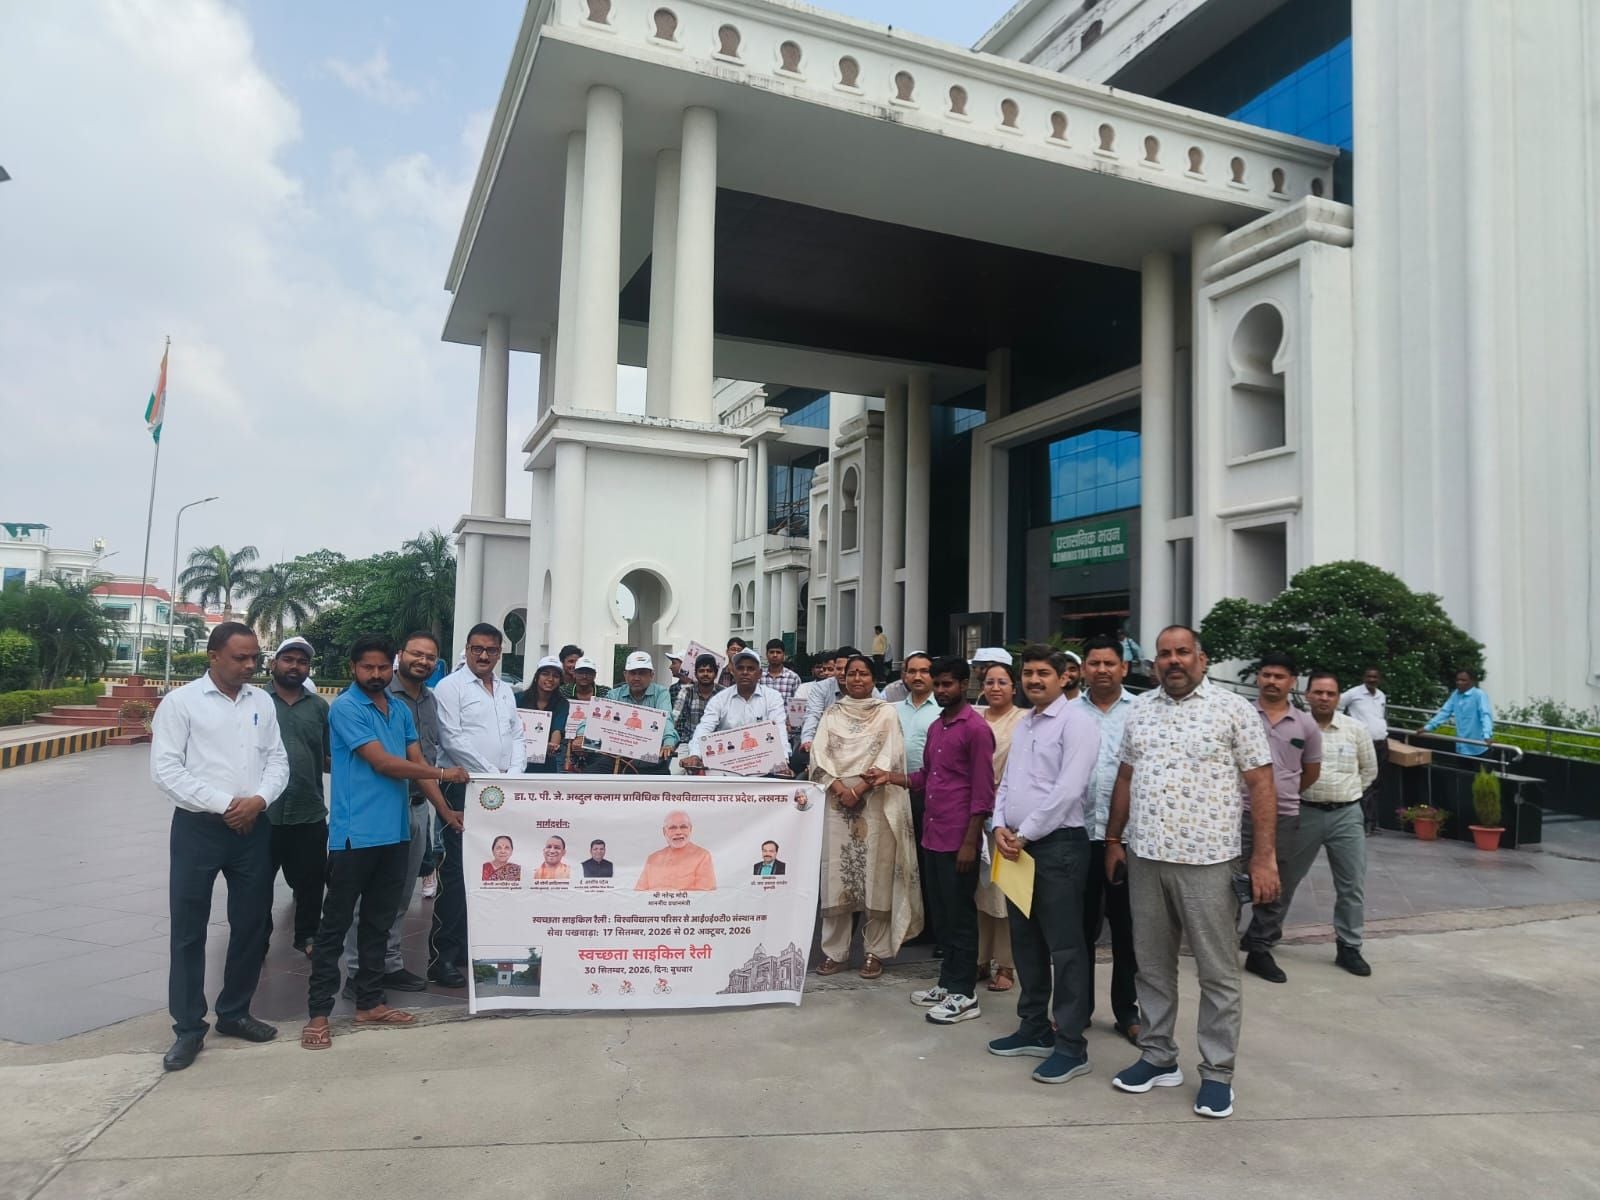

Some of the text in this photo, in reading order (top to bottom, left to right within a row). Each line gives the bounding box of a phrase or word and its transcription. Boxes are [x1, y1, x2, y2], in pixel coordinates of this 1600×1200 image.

[1052, 543, 1124, 563] ADMINISTRATIVE BLOCK
[514, 790, 788, 804] डा. ए. पी. जे. अब्दुल कलाम प्राविधिक विश्वविद्यालय उत्तर प्रदेश, लखनऊ
[532, 916, 560, 924] स्वच्छता
[562, 914, 592, 925] साइकिल
[614, 914, 659, 924] विश्वविद्यालय
[661, 913, 681, 923] परिसर
[683, 914, 689, 922] से
[732, 913, 755, 921] संस्थान
[547, 927, 562, 937] सेवा
[603, 928, 613, 936] 17
[648, 928, 671, 936] 2026
[674, 927, 680, 935] से
[729, 927, 751, 935] 2026
[578, 943, 712, 962] स्वच्छता साइकिल रैली
[584, 966, 596, 974] 30
[670, 966, 693, 975] बुधवार
